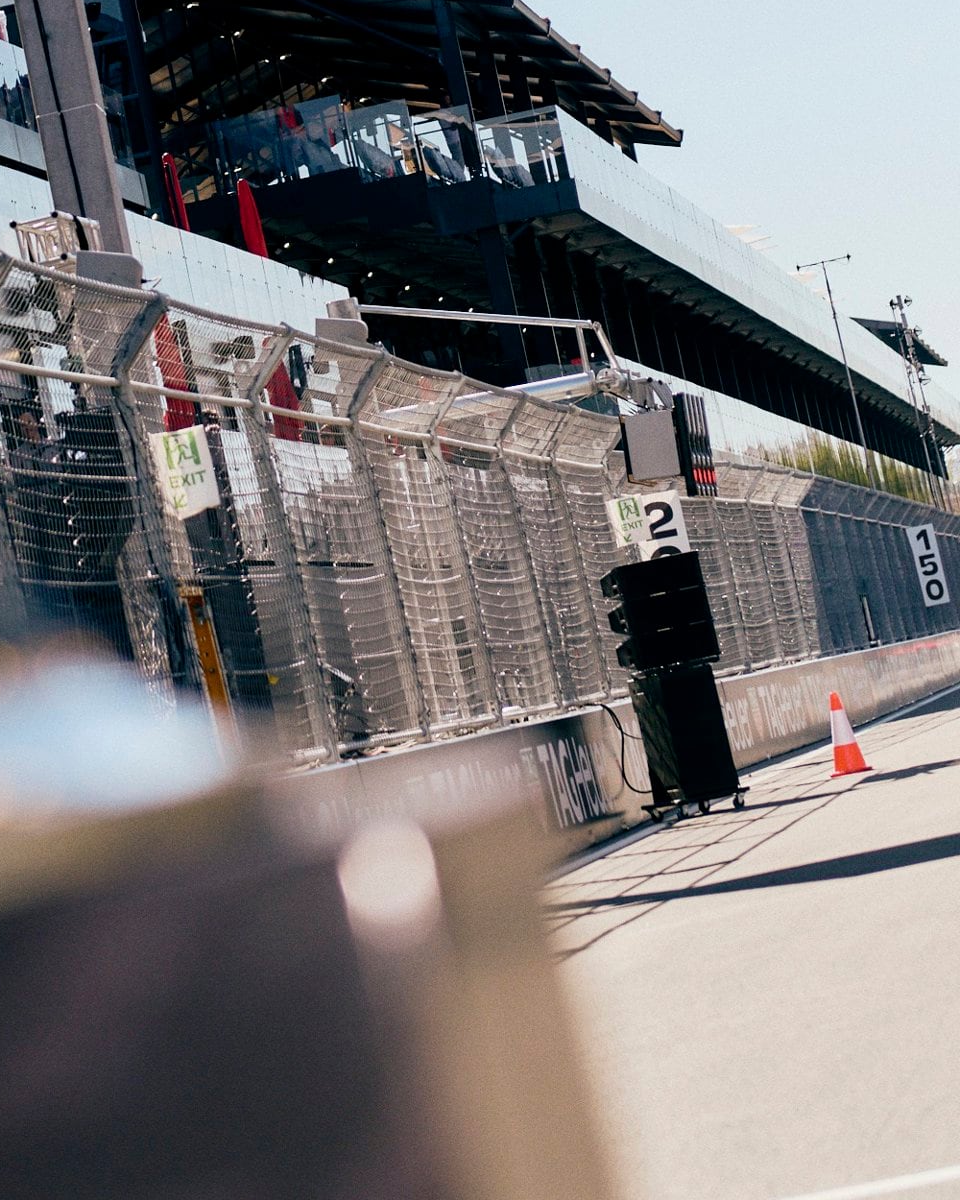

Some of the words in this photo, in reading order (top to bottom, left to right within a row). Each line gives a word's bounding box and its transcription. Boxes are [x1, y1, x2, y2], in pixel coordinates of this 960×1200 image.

[169, 470, 206, 489] EXIT
[621, 519, 643, 532] EXIT
[916, 528, 945, 601] 150
